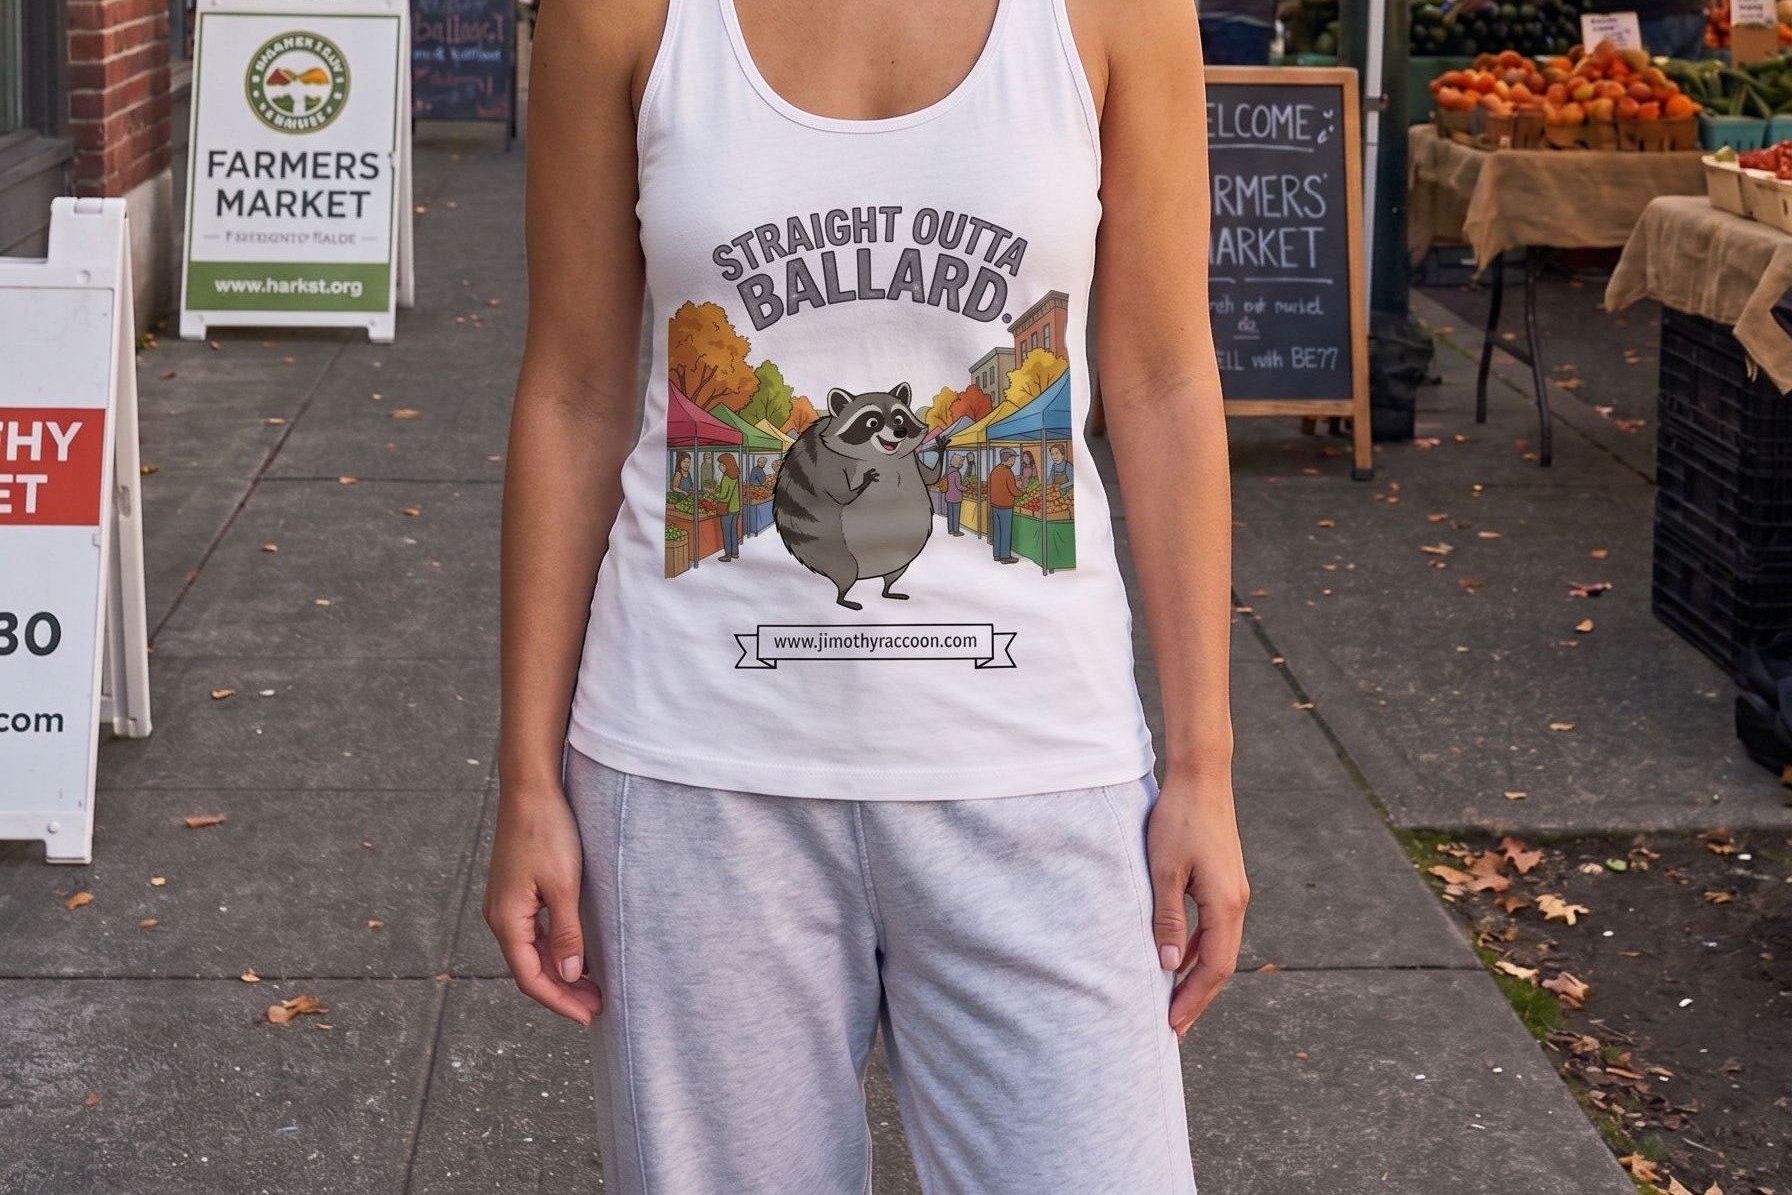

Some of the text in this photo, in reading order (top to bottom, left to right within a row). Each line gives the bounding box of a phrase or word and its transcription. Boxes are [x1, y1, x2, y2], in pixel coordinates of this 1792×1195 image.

[1206, 103, 1315, 140] ELCOME
[207, 150, 380, 180] FARMERS
[216, 188, 371, 218] MARKET
[712, 206, 1028, 282] STRAIGHT OUTTA
[1208, 227, 1325, 269] ARKET
[0, 421, 83, 462] HY
[774, 632, 978, 653] www.jimothyraccoon.com
